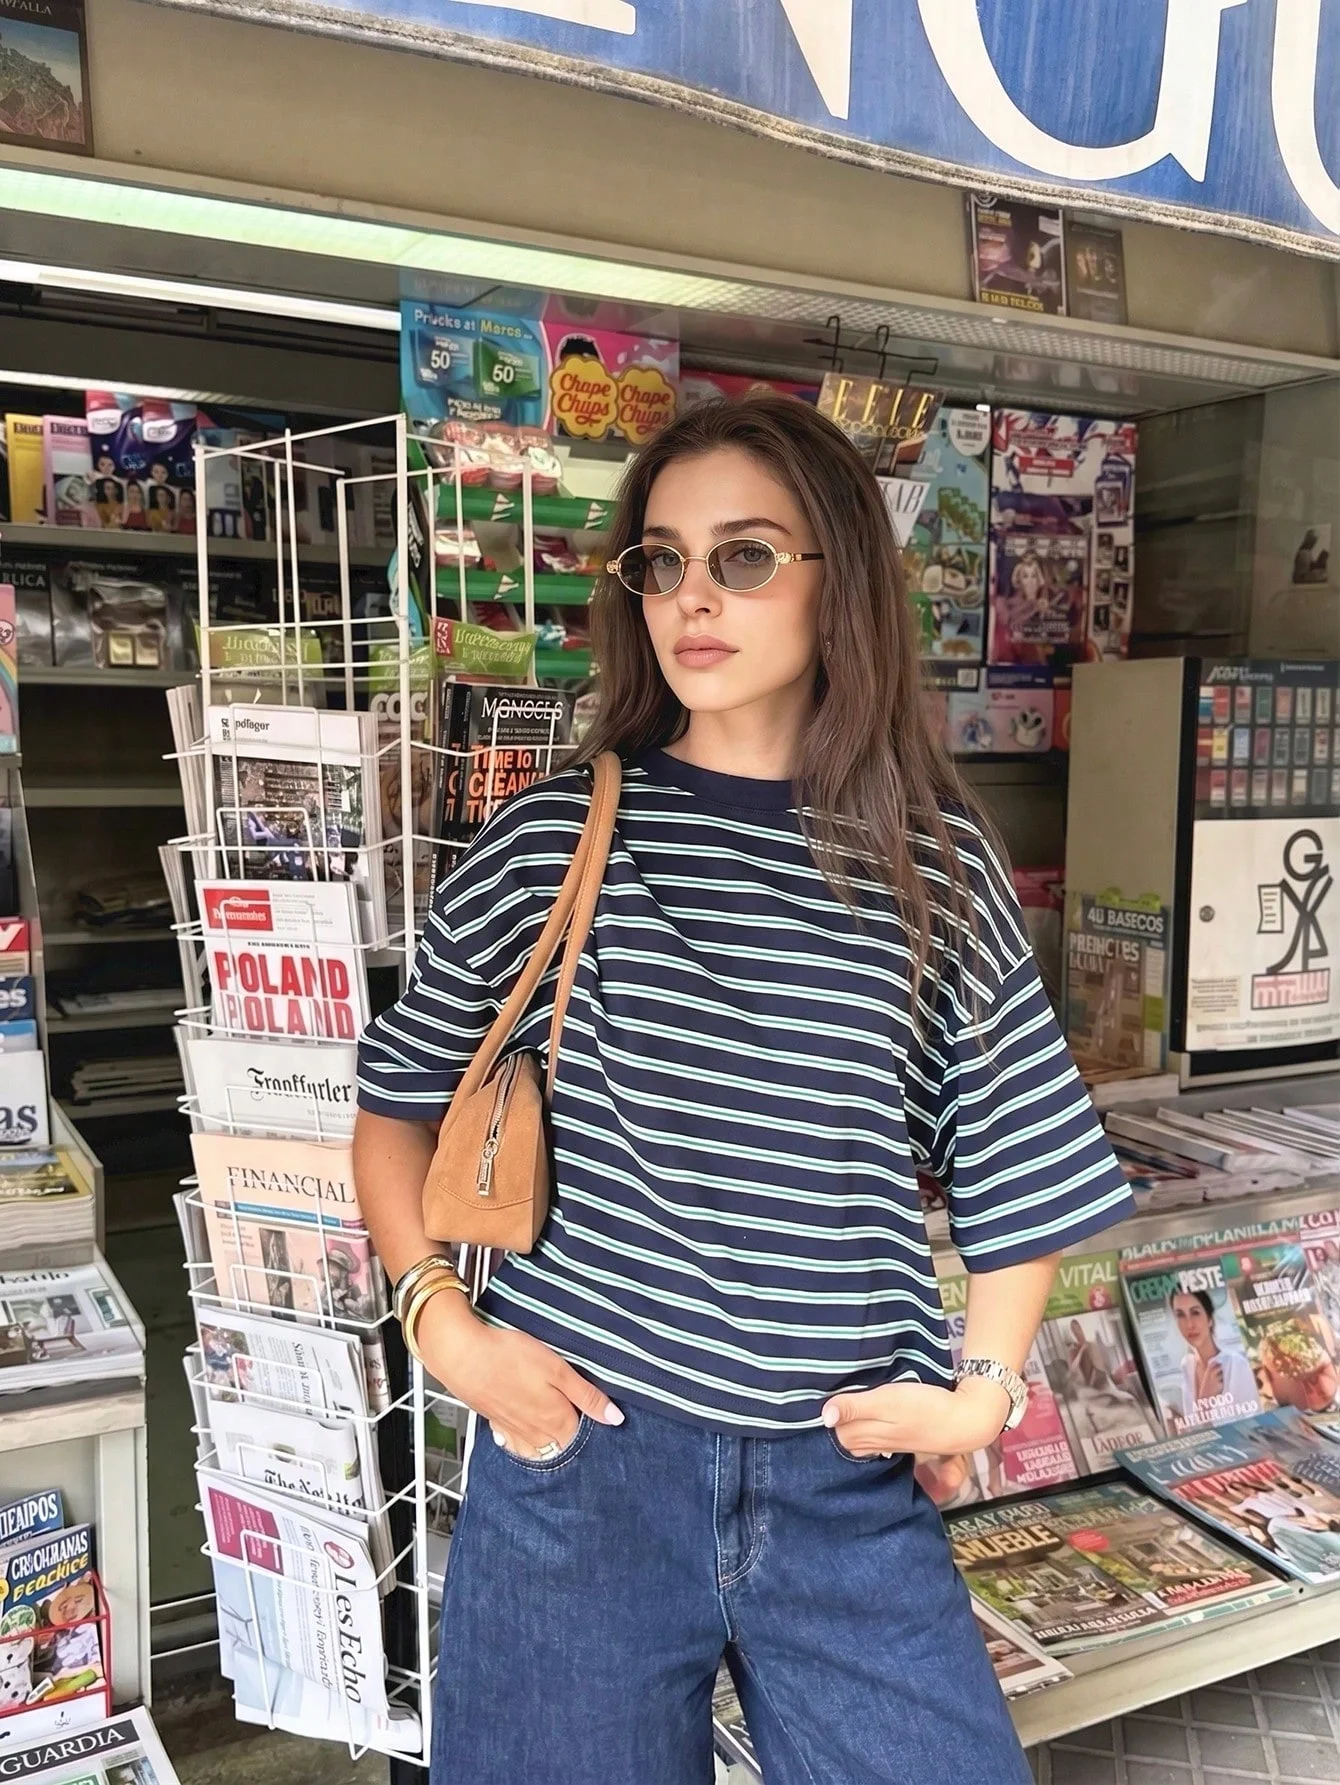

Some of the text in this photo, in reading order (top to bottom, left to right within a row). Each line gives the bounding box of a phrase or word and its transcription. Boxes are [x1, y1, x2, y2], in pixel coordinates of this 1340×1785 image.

[430, 349, 451, 369] 50
[557, 392, 610, 427] Chups
[214, 951, 350, 1000] POLAND
[226, 1165, 356, 1204] FINANCIAL
[1059, 1260, 1118, 1289] VITAL
[334, 1572, 357, 1628] Les
[0, 1727, 126, 1775] GUARDIA
